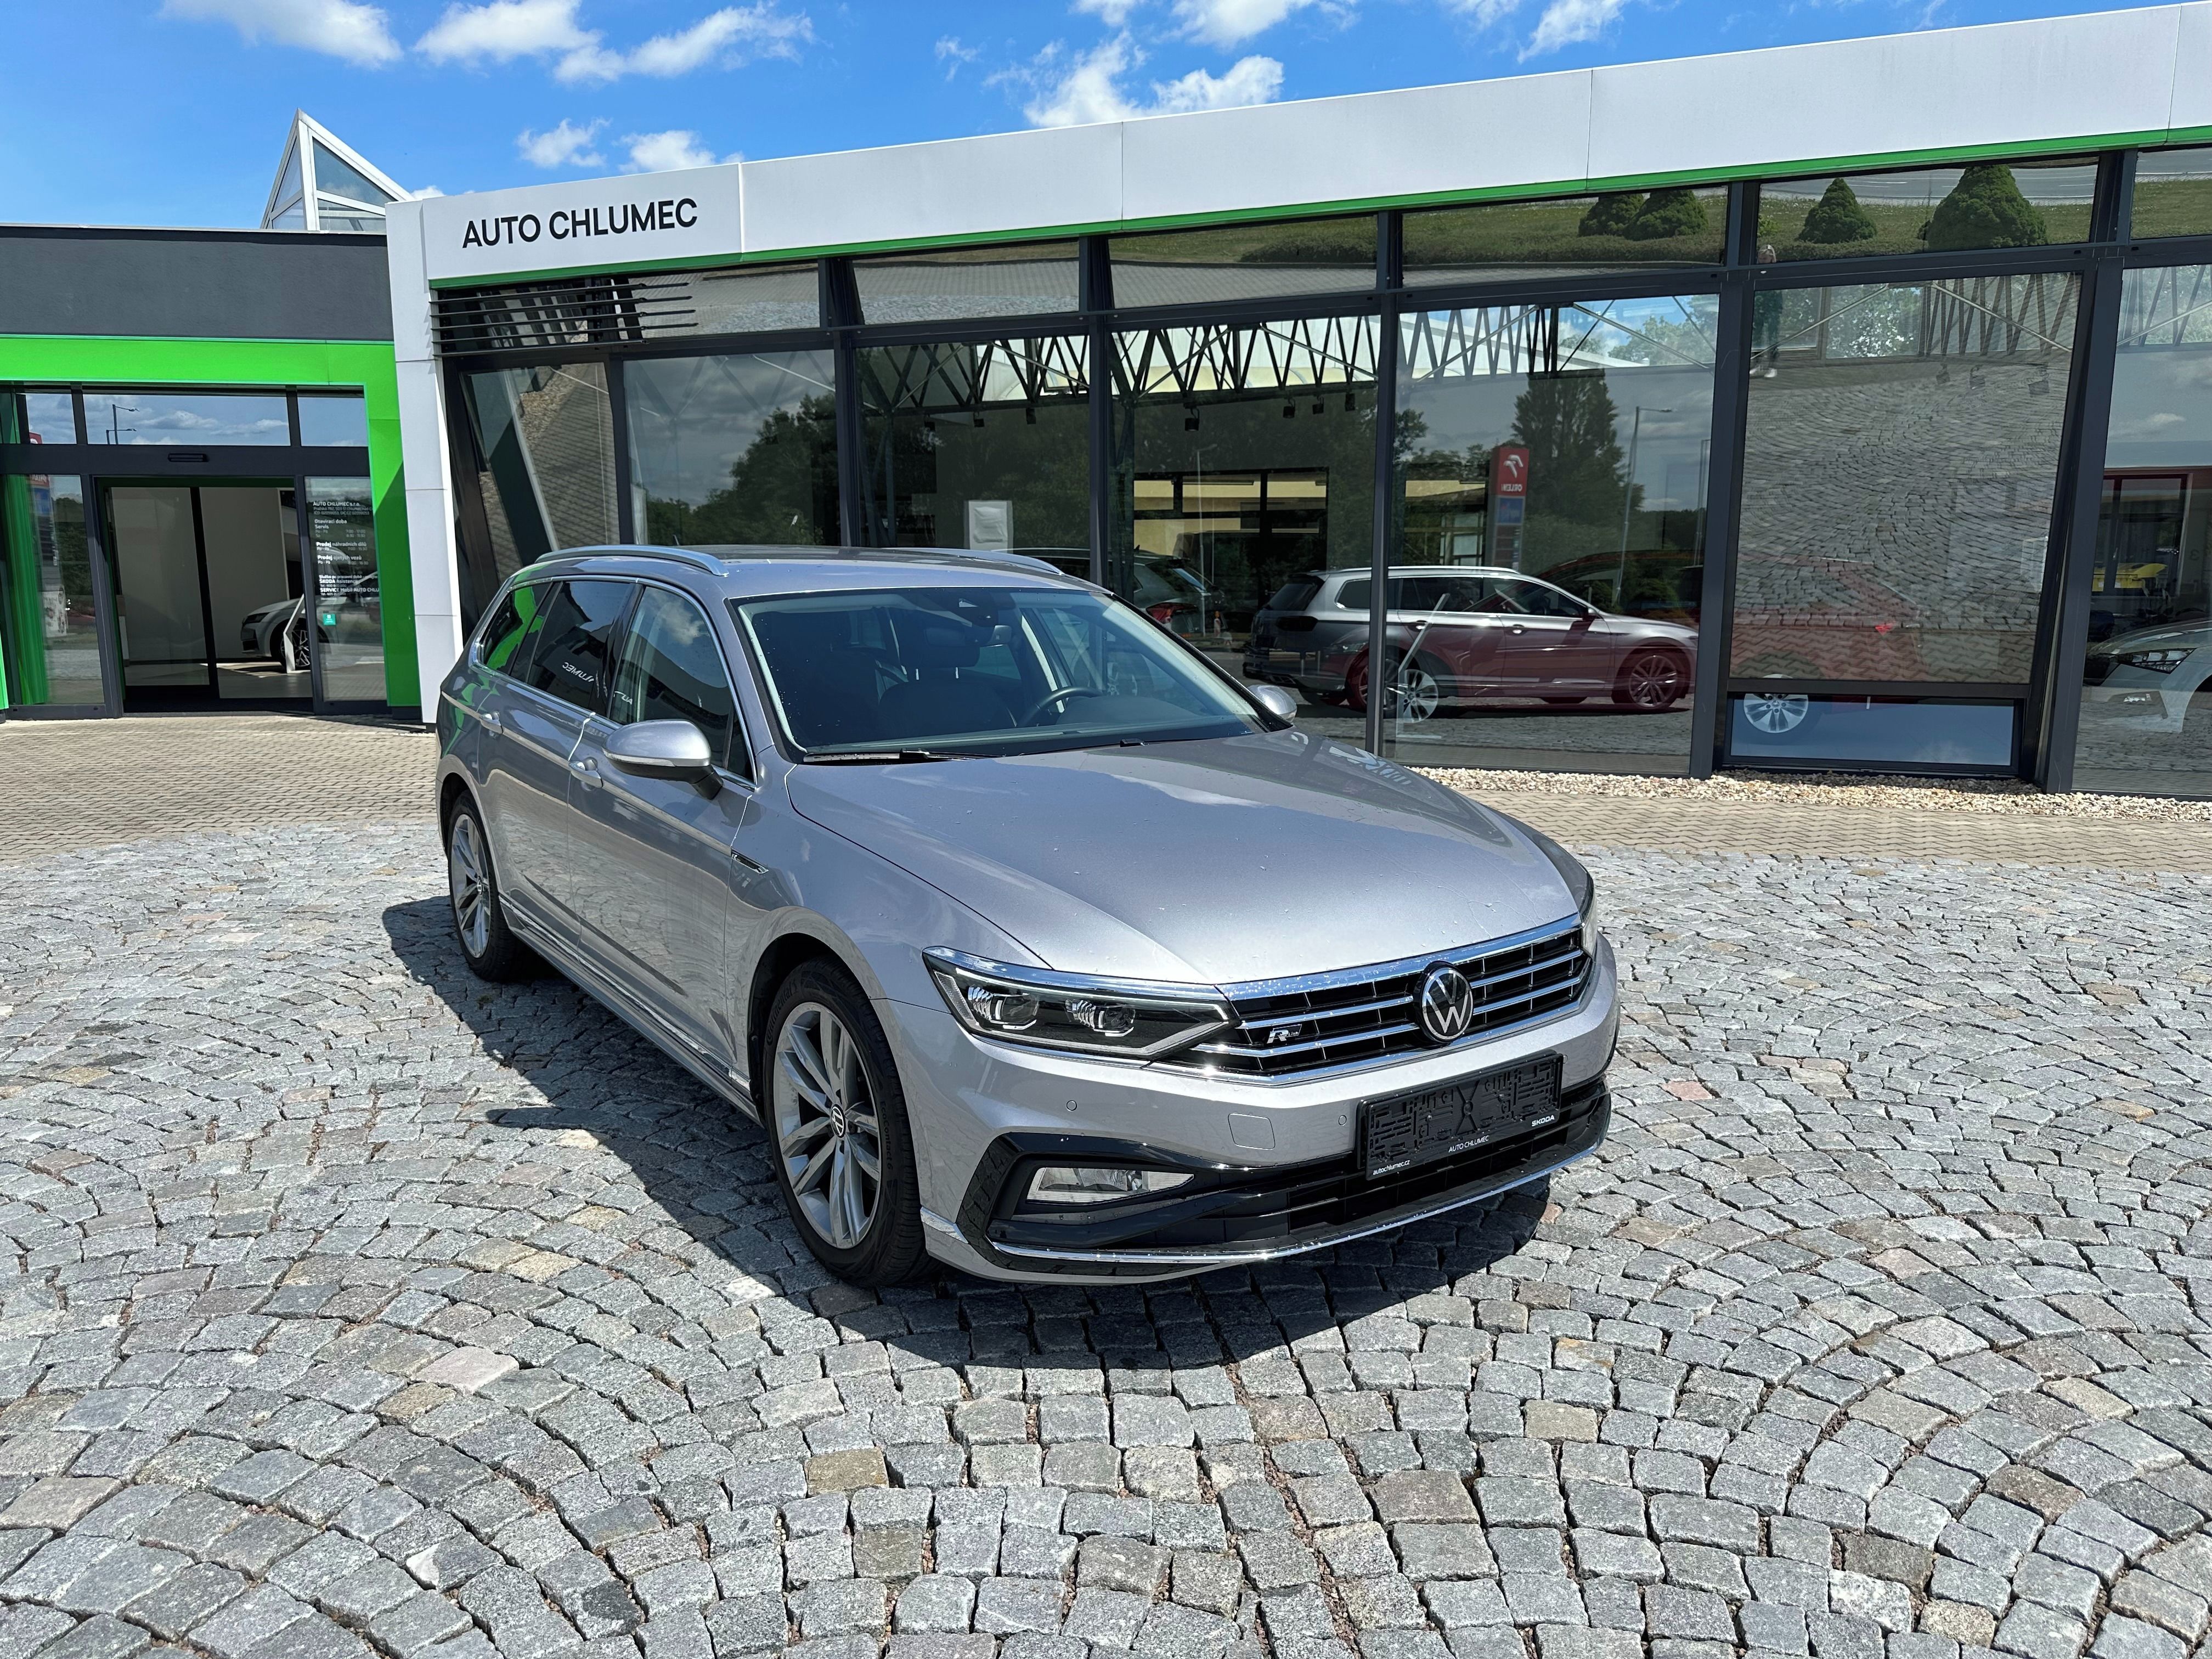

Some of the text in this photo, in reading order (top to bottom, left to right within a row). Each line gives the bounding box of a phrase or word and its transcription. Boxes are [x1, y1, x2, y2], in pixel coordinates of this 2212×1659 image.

[462, 198, 698, 249] AUTO CHLUMEC
[1448, 1135, 1490, 1153] AUTO CHLUMEC
[1373, 1160, 1410, 1176] autochlumec.cz
